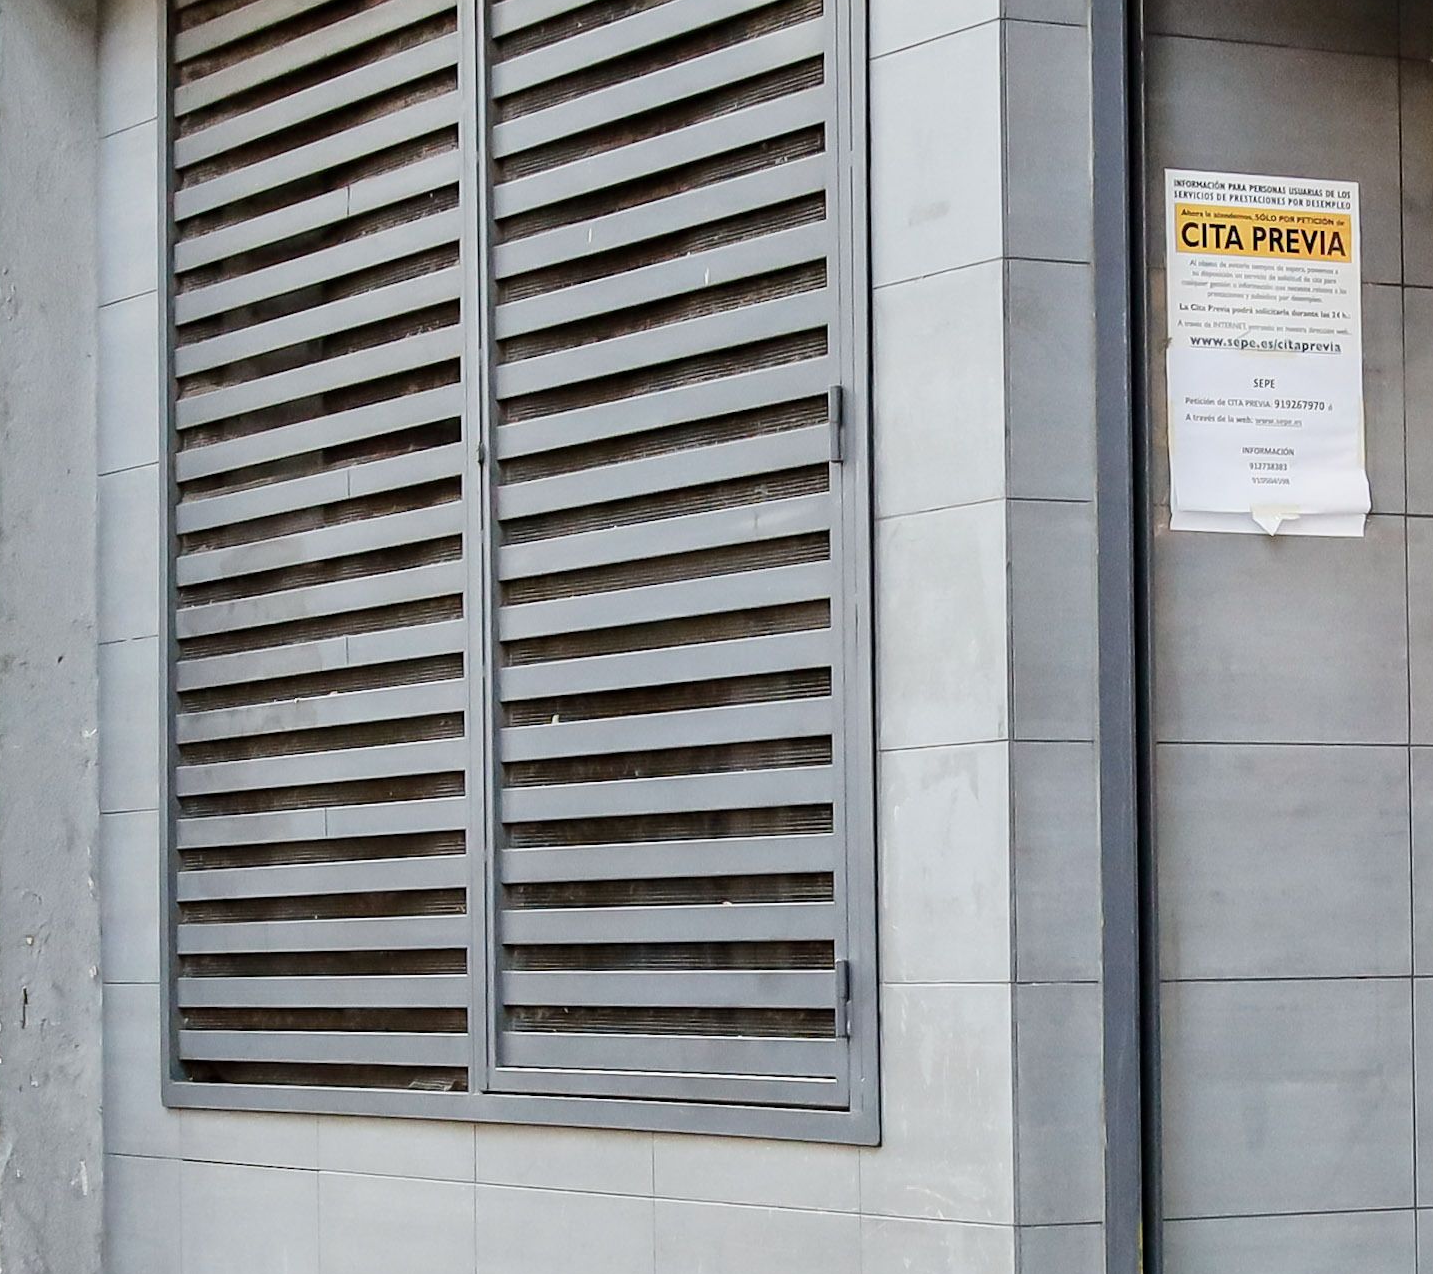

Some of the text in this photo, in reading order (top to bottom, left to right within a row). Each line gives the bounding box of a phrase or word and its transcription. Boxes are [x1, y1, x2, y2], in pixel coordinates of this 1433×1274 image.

[1174, 179, 1351, 199] INFORMACIÓN PARA PERSONAS USUARIAS DE LOS
[1174, 190, 1351, 211] SERVICIOS DE PRESTACIONES POR DESEMPLEO
[1255, 213, 1277, 223] SÓLO
[1181, 222, 1346, 257] CITA PREVIA
[1190, 336, 1342, 353] www.sepe.es/citaprevia
[1253, 378, 1276, 389] SEPE
[1185, 397, 1216, 406] Petición
[1217, 398, 1225, 406] de
[1274, 399, 1326, 411] 919267970
[1185, 413, 1191, 421] A
[1217, 415, 1226, 423] de
[1242, 446, 1295, 456] INFORMACIÓN
